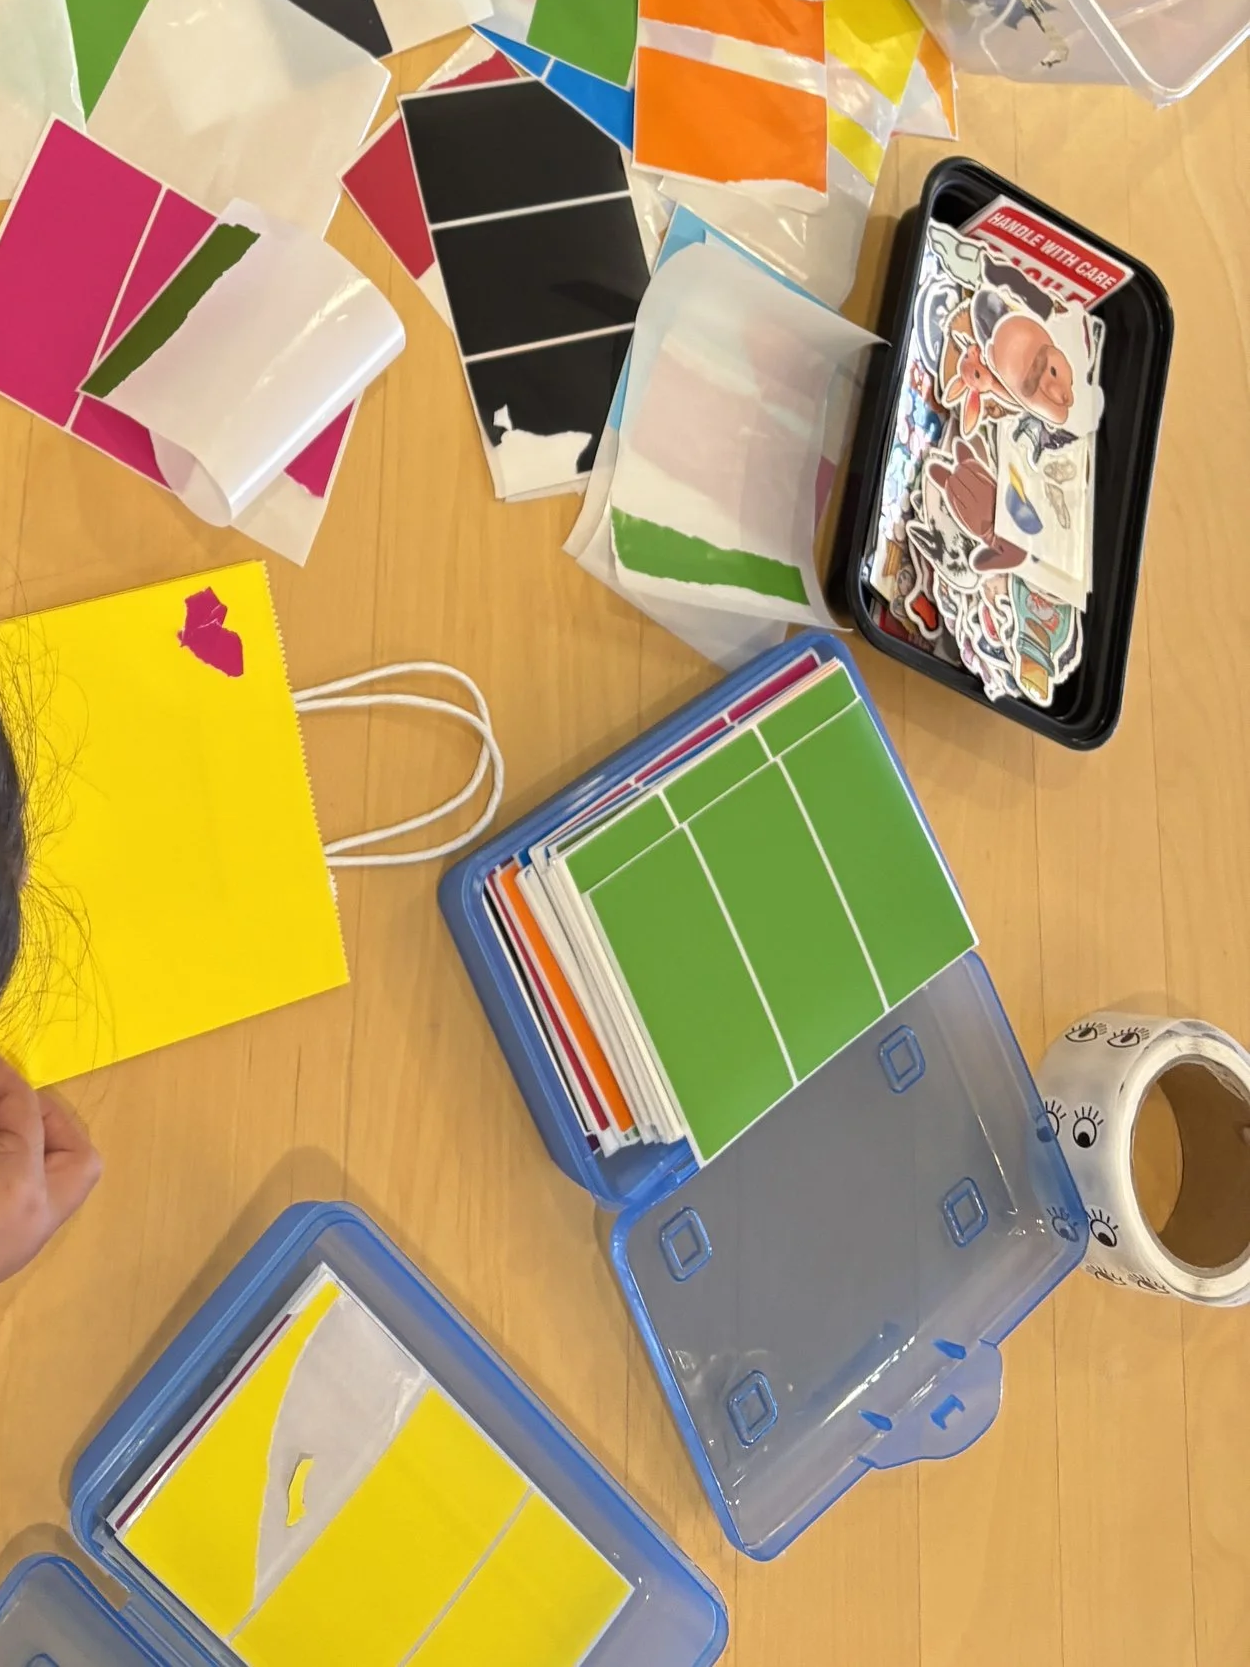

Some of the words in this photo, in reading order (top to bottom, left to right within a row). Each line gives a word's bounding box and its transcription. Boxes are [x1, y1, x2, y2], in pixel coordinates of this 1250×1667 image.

[987, 212, 1042, 246] HANDLE
[1040, 239, 1077, 268] WITH
[1075, 257, 1117, 290] CARE
